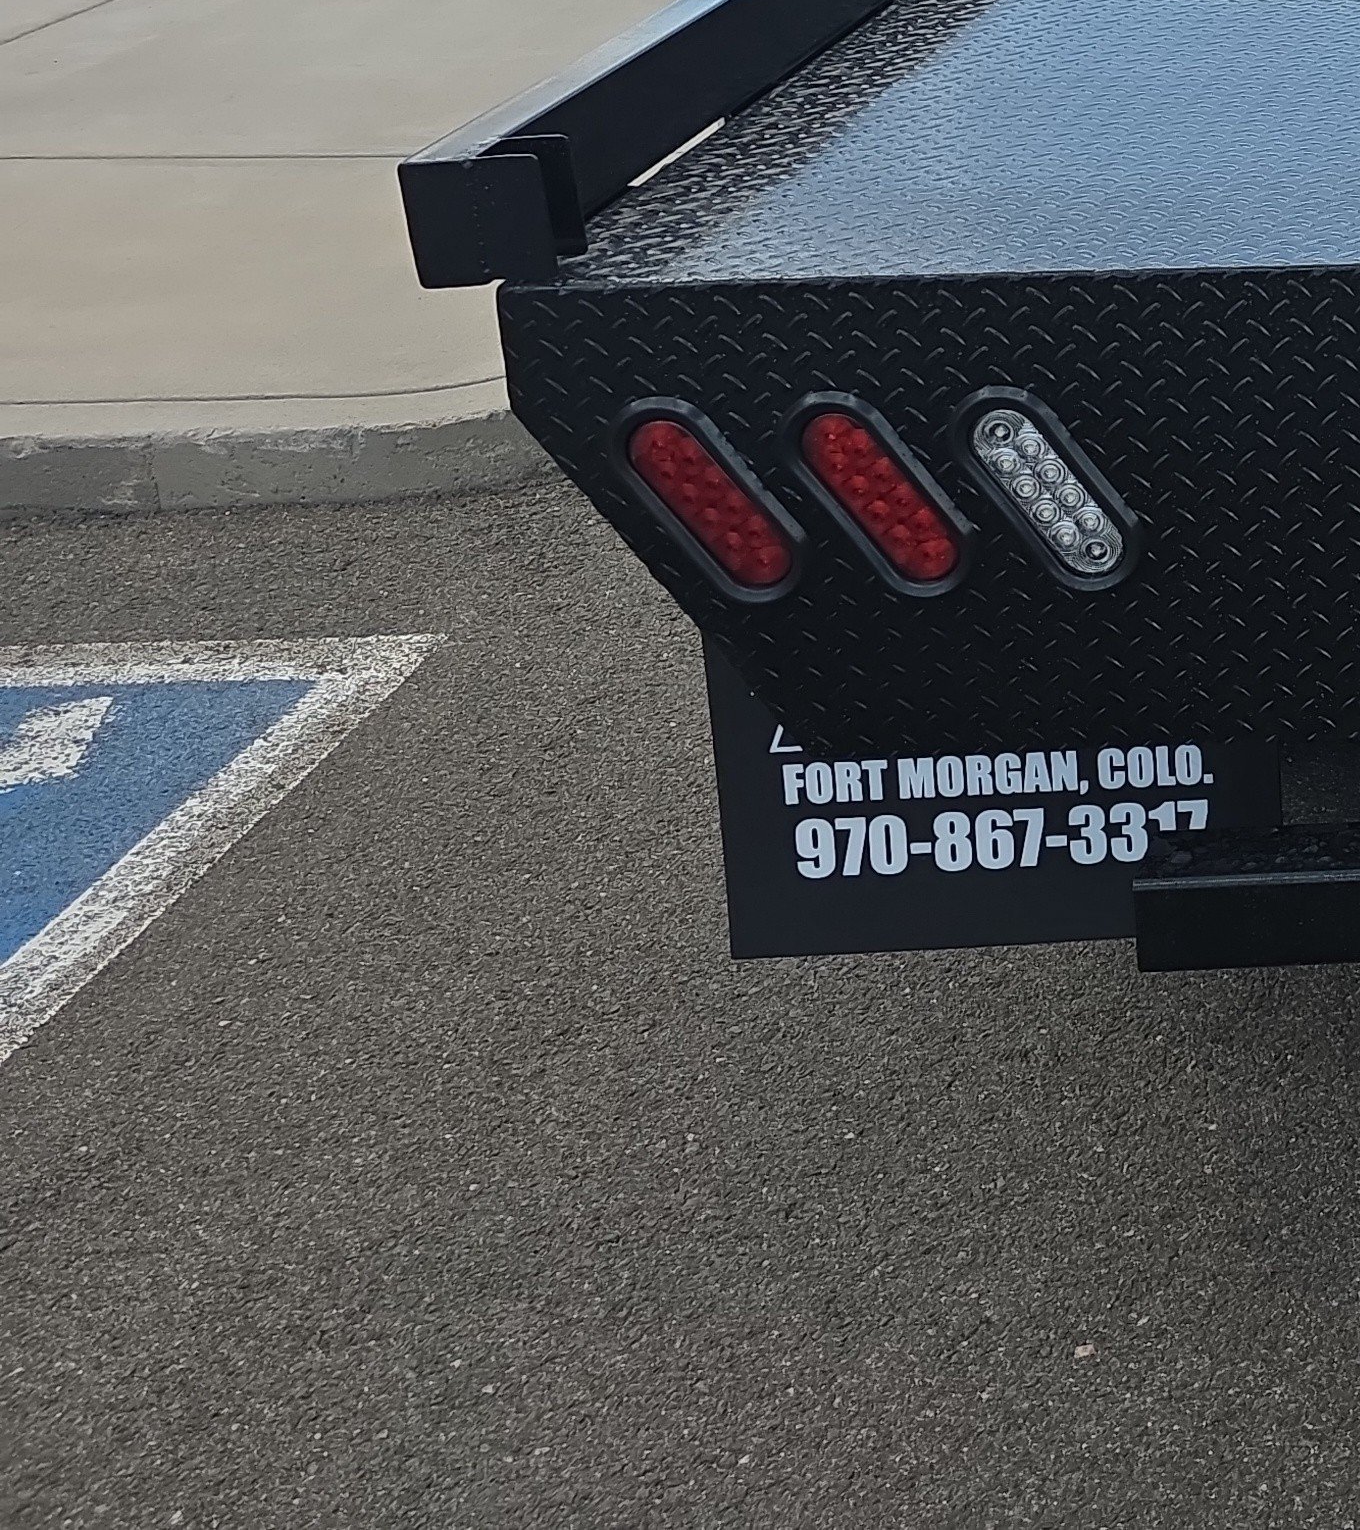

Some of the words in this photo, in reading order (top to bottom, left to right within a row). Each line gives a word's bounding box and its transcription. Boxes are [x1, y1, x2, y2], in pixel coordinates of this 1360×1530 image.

[783, 759, 888, 806] FORT
[897, 750, 1089, 800] MORGAN,
[1097, 744, 1214, 790] COLO.
